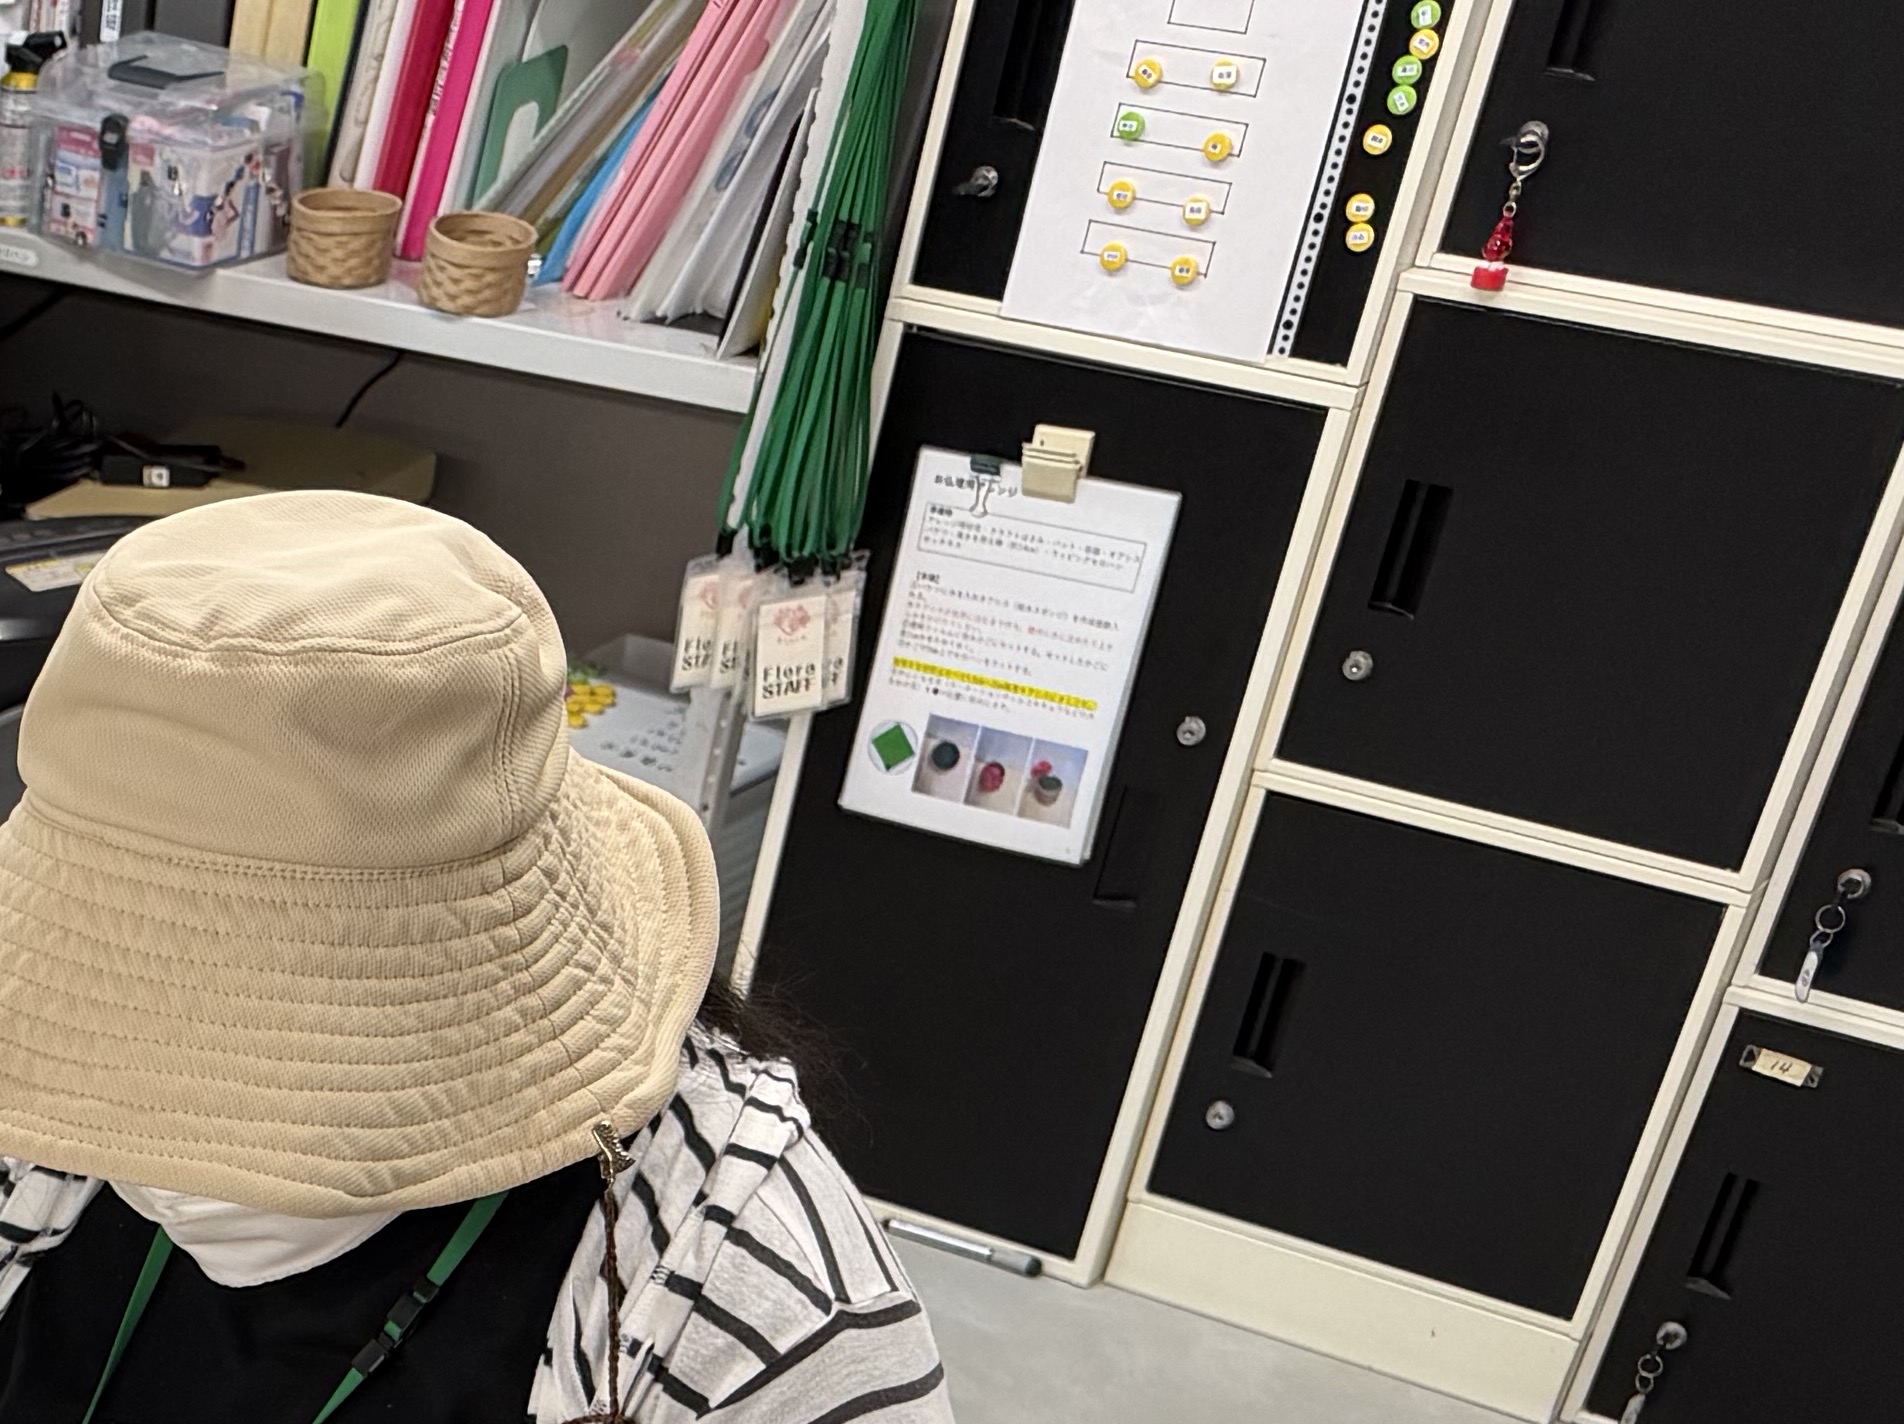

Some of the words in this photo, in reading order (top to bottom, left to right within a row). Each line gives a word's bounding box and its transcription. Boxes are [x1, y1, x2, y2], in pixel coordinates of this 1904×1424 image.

[763, 663, 816, 682] Flora
[762, 678, 816, 700] STAFF
[1771, 1061, 1792, 1074] 14
